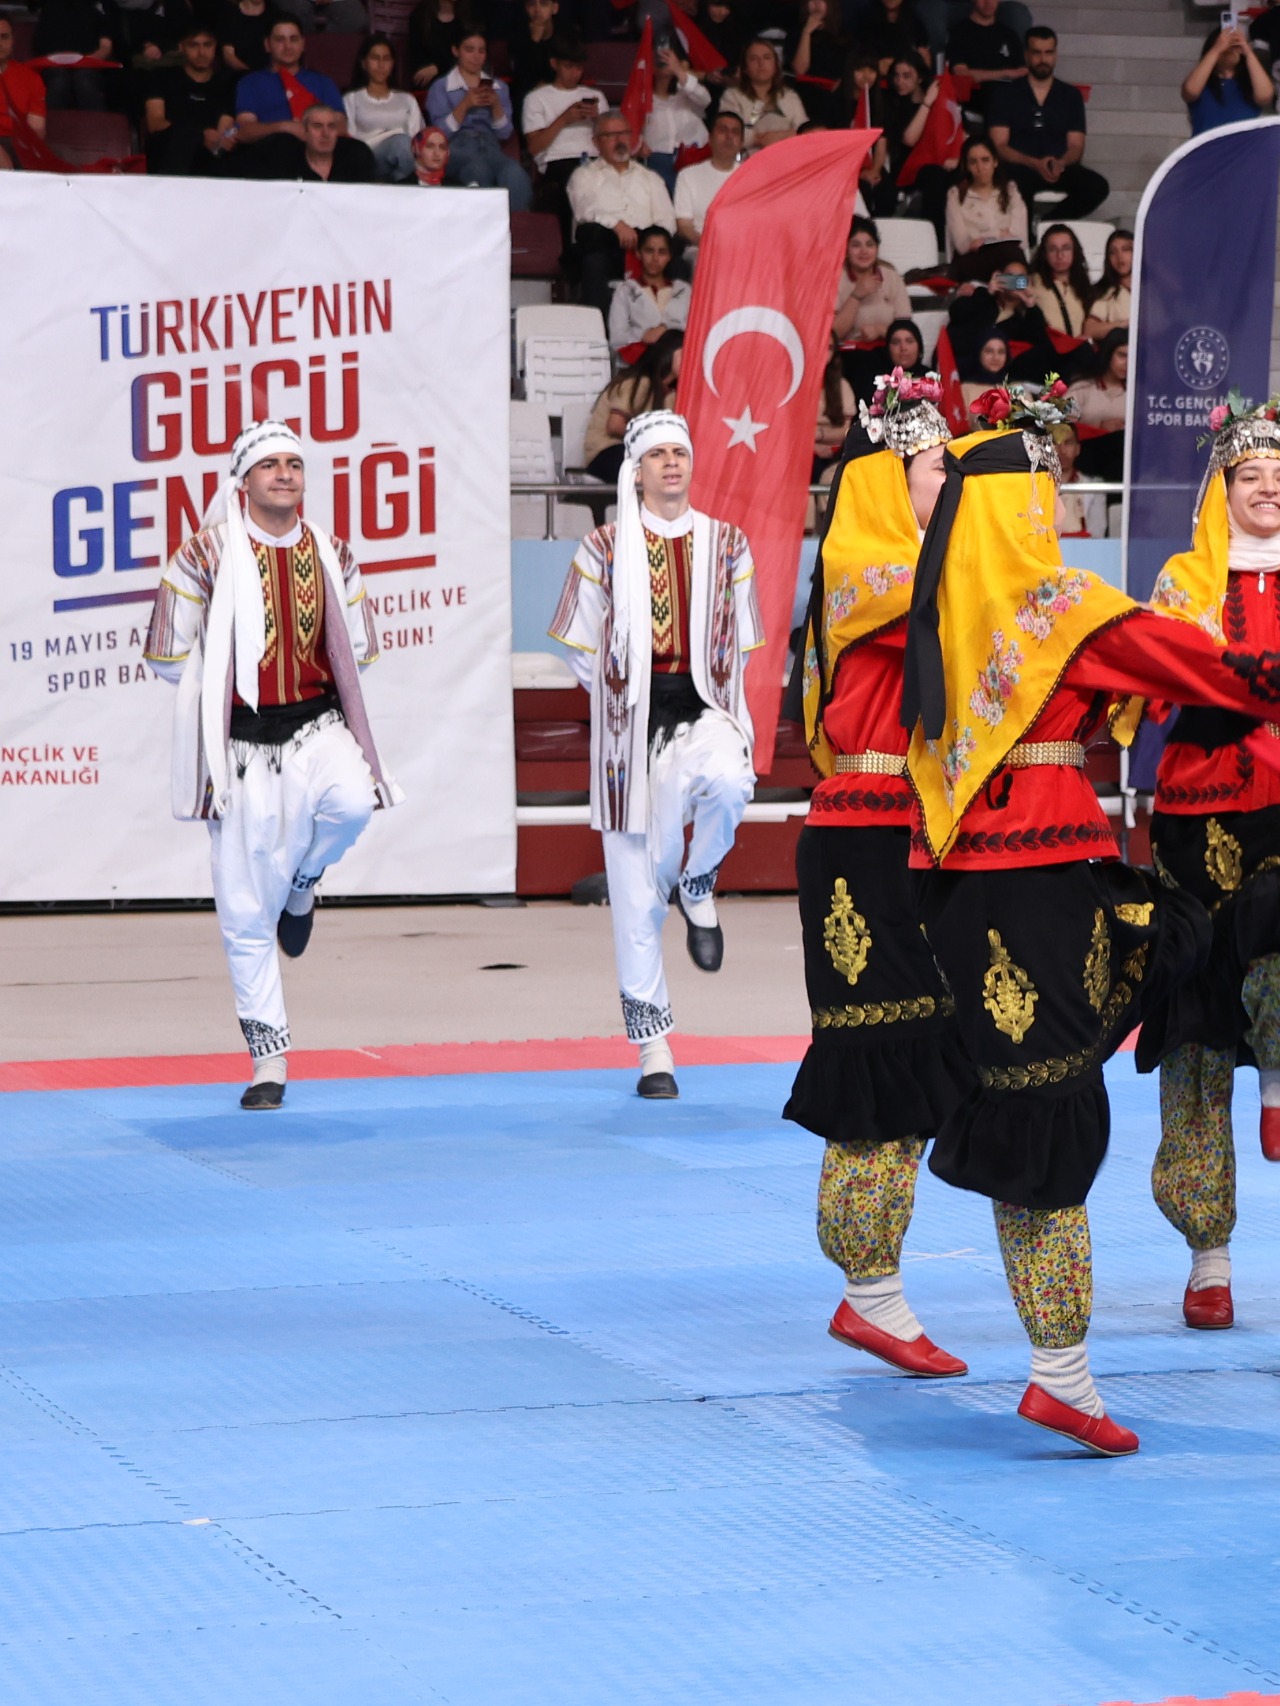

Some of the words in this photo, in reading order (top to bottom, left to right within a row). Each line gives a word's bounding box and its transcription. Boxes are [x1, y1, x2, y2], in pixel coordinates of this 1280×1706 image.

[90, 278, 393, 363] TÜRKİYE'NİN
[130, 351, 360, 464] GÜCÜ
[1147, 395, 1172, 409] T.C.
[1175, 395, 1231, 412] GENÇLİ
[1147, 412, 1182, 427] SPOR
[52, 442, 437, 578] GENİĞİ
[10, 640, 33, 662] 19
[45, 630, 118, 658] MAYIS
[442, 585, 468, 608] VE
[48, 667, 107, 694] SPOR
[73, 746, 100, 762] VE
